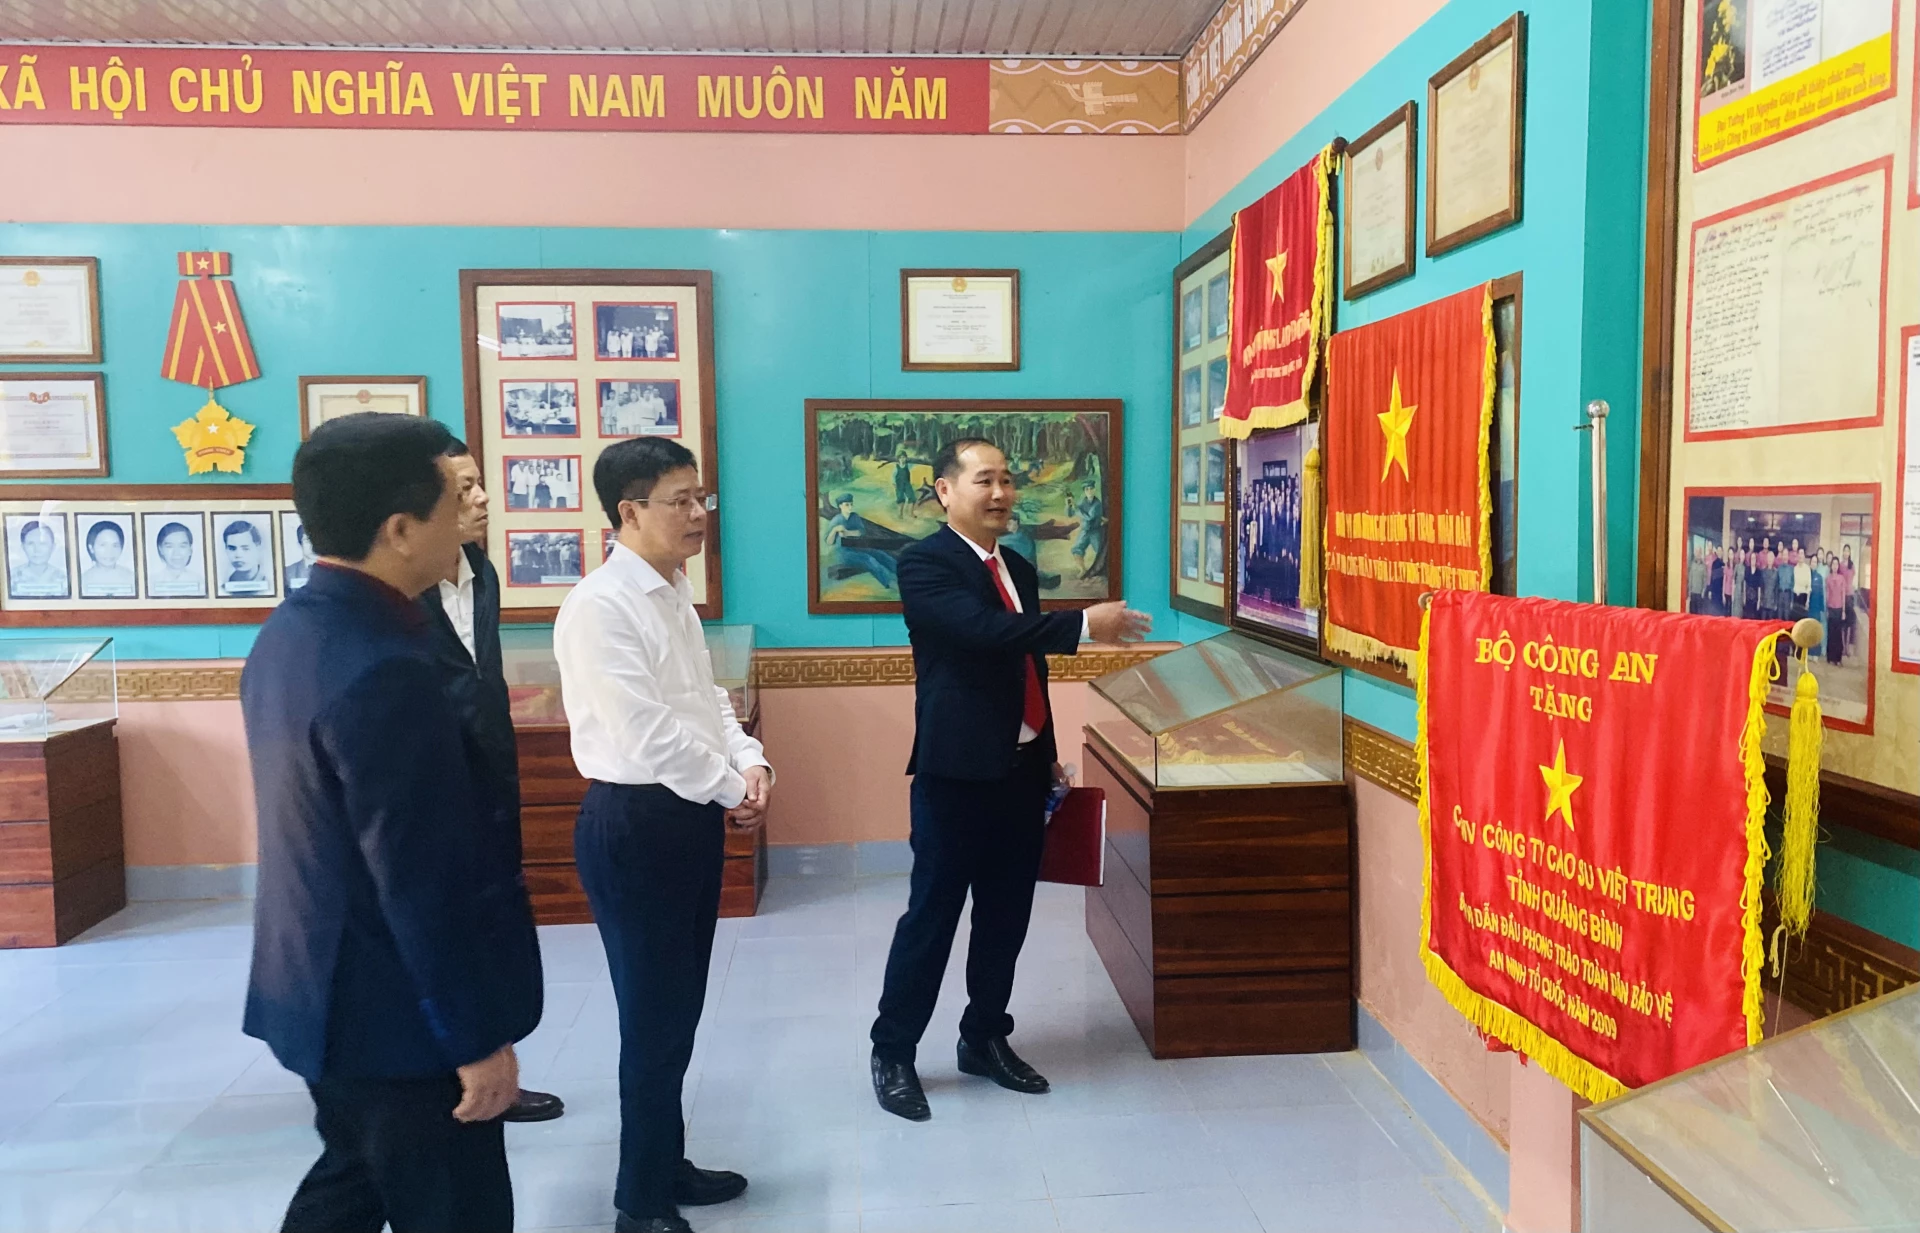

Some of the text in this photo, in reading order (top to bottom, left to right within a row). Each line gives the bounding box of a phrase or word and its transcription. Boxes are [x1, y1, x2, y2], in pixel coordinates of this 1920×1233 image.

[70, 57, 146, 120] HỘI
[169, 54, 263, 115] CHỦ
[292, 60, 434, 116] NGHĨA
[453, 62, 547, 123] VIỆT
[569, 73, 665, 118] NAM
[698, 65, 824, 119] MUÔN
[855, 66, 947, 120] NĂM
[1475, 629, 1658, 684] BỘ CÔNG AN
[1530, 683, 1593, 722] TẶNG
[1482, 821, 1526, 859] CÔNG
[1530, 837, 1545, 867] TY
[1547, 845, 1576, 880] CAO
[1578, 859, 1594, 890] SU
[1597, 866, 1628, 910] VIỆT
[1632, 880, 1695, 922] TRUNG
[1507, 869, 1540, 912] TỈNH
[1542, 889, 1588, 935] QUẢNG
[1590, 910, 1622, 953] BÌNH
[1488, 950, 1618, 1040] AN NINH TỔ QUỐC NĂM 2009
[1523, 925, 1553, 958] PHONG
[1554, 944, 1579, 977] TRÀO
[1582, 958, 1608, 993] TOÀN
[1631, 981, 1652, 1016] BẢO
[1656, 991, 1673, 1029] VỆ
